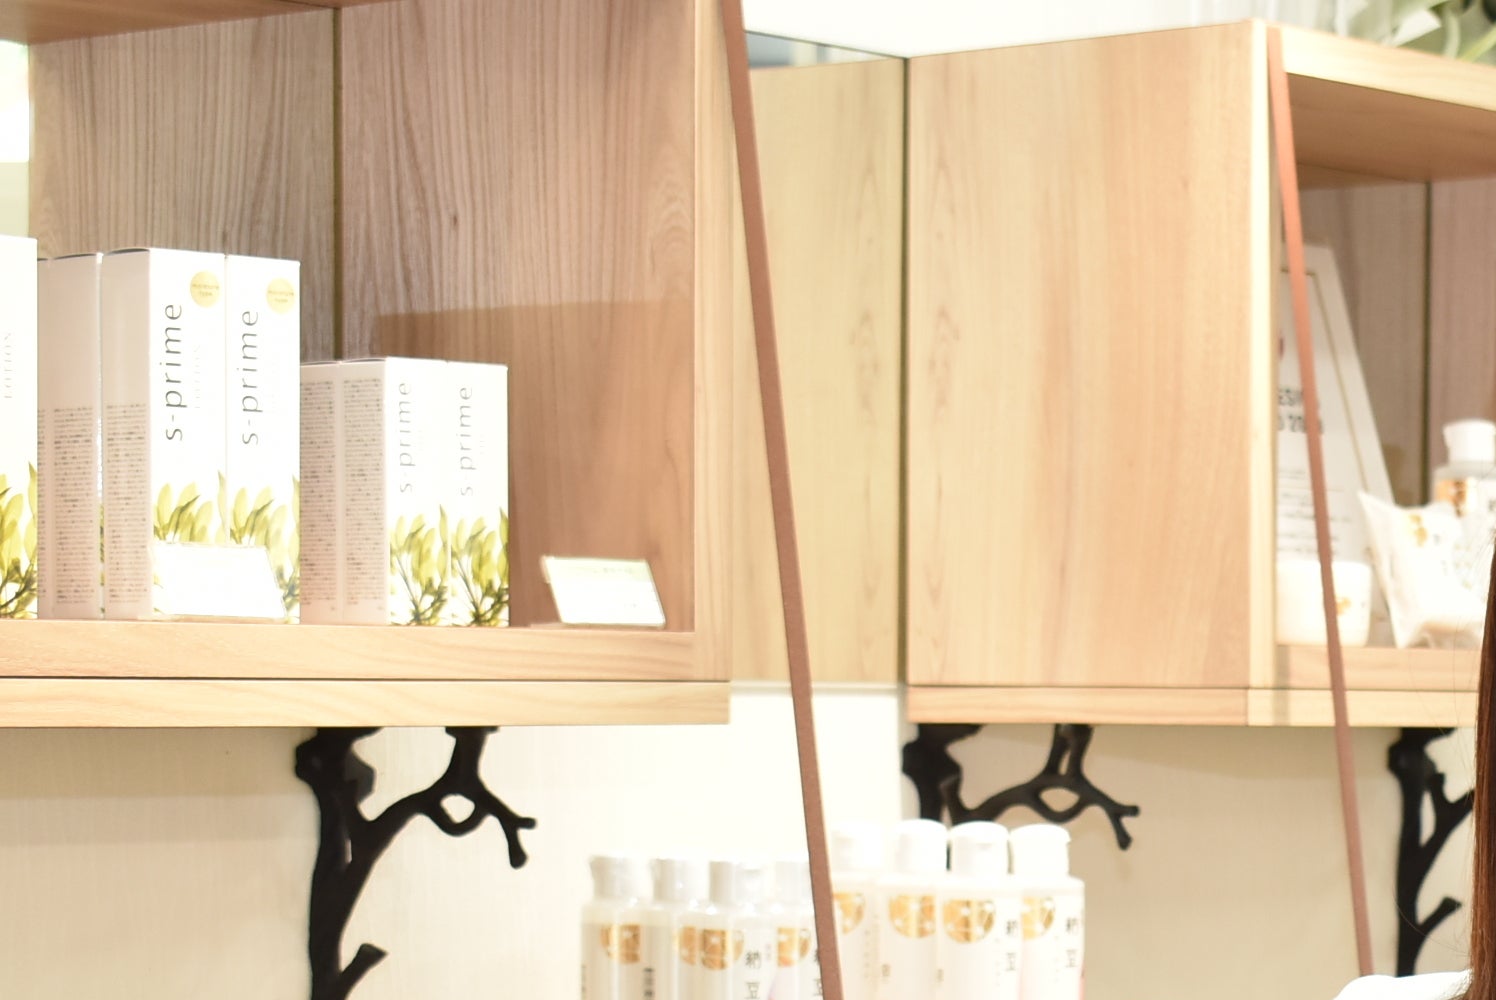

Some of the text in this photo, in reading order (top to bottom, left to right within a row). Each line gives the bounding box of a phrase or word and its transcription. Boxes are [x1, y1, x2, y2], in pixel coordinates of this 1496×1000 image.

[159, 303, 188, 441] s-prime
[236, 310, 263, 445] s-prime
[398, 382, 416, 493] s-prime
[456, 386, 476, 497] s-prime
